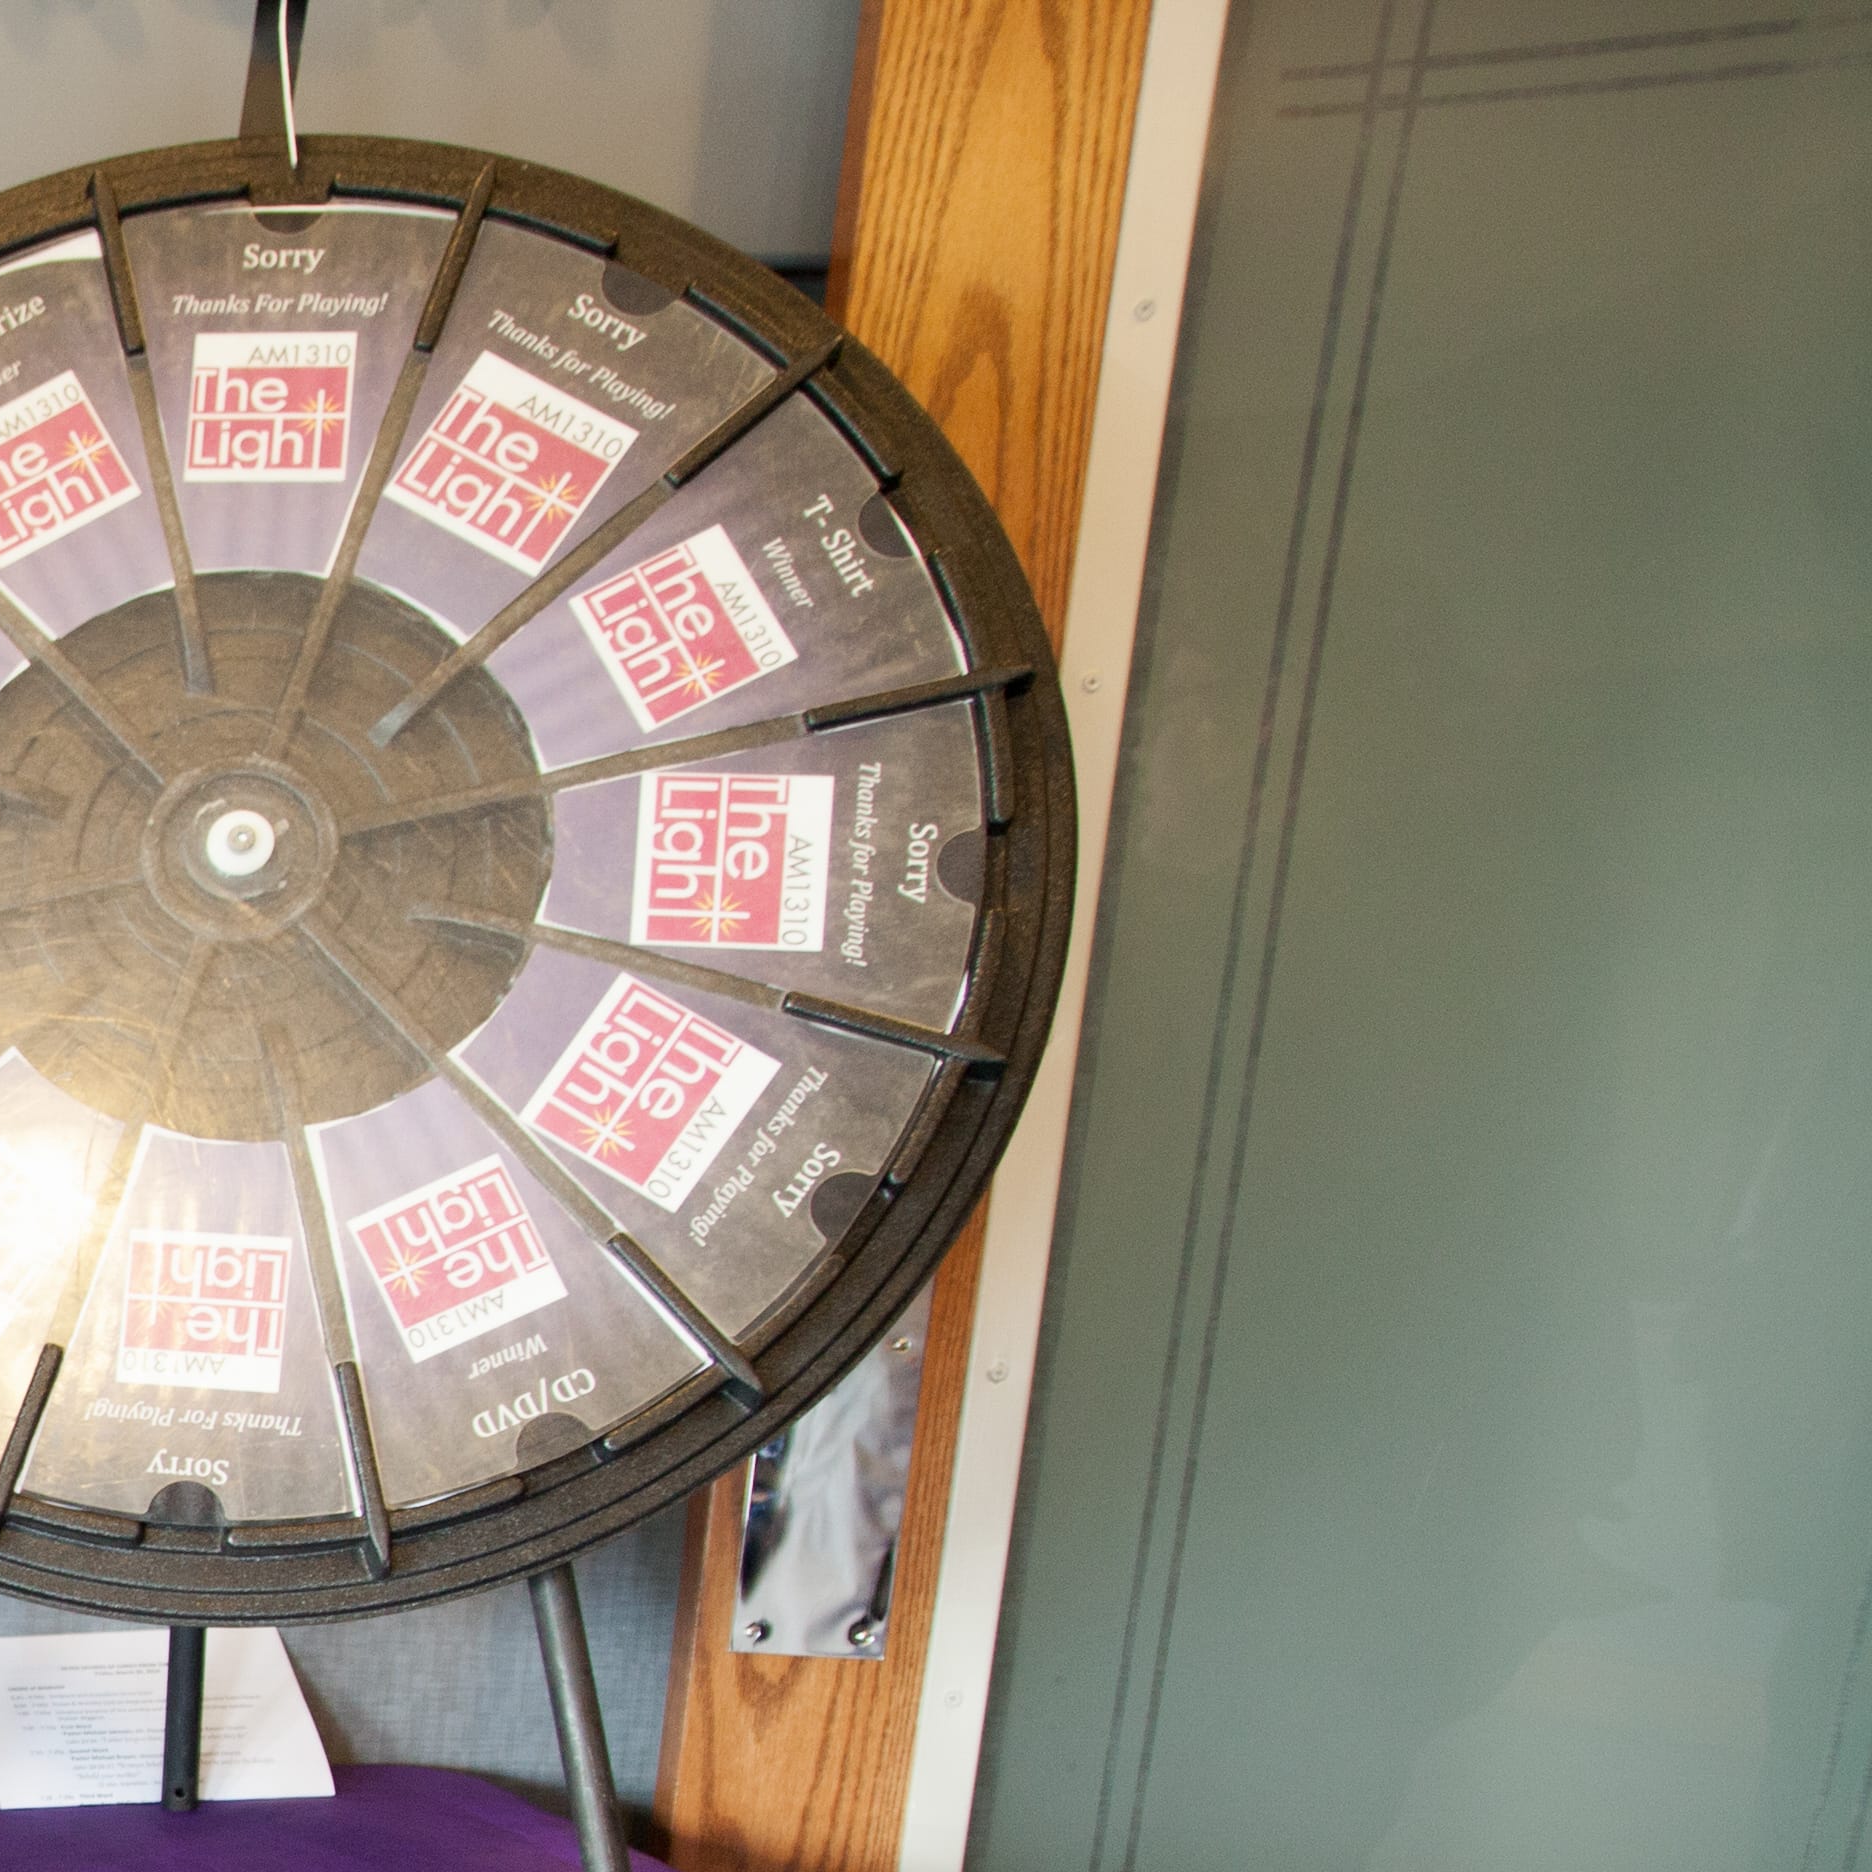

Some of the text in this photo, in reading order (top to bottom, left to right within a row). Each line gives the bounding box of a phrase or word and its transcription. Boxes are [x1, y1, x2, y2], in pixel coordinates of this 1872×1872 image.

[243, 243, 325, 274] Sorry
[173, 293, 388, 317] Thanks For Playing!
[567, 294, 646, 351] Sorry
[195, 368, 287, 413] The
[248, 344, 350, 364] AM1310
[488, 310, 676, 420] Thanks for Playing!
[192, 389, 326, 470] Light
[438, 386, 539, 472] The
[517, 393, 623, 459] AM1310
[402, 441, 572, 551] Light
[643, 545, 716, 640] The
[762, 537, 815, 608] Winner
[590, 577, 725, 704] Light
[716, 581, 782, 669] AM1310
[647, 781, 750, 918] Light
[726, 778, 788, 880] The
[841, 762, 881, 966] Thanks for Playing!
[898, 824, 937, 903] Sorry
[782, 835, 812, 945] AM1310
[546, 991, 680, 1151] Light
[638, 1022, 743, 1121] The
[649, 1095, 728, 1199] AM1310
[689, 1065, 828, 1248] Thanks for Playing!
[772, 1142, 841, 1218] Sorry
[379, 1173, 518, 1298] Light
[443, 1223, 549, 1289] The
[150, 1244, 284, 1325] Light
[408, 1290, 504, 1349] AM1310
[123, 1351, 226, 1374] AM1310
[186, 1305, 280, 1355] The
[468, 1334, 548, 1380] Winner
[85, 1398, 302, 1435] Thanks For Playing!
[472, 1368, 596, 1438] CD/DVD
[146, 1449, 229, 1485] Sorry
